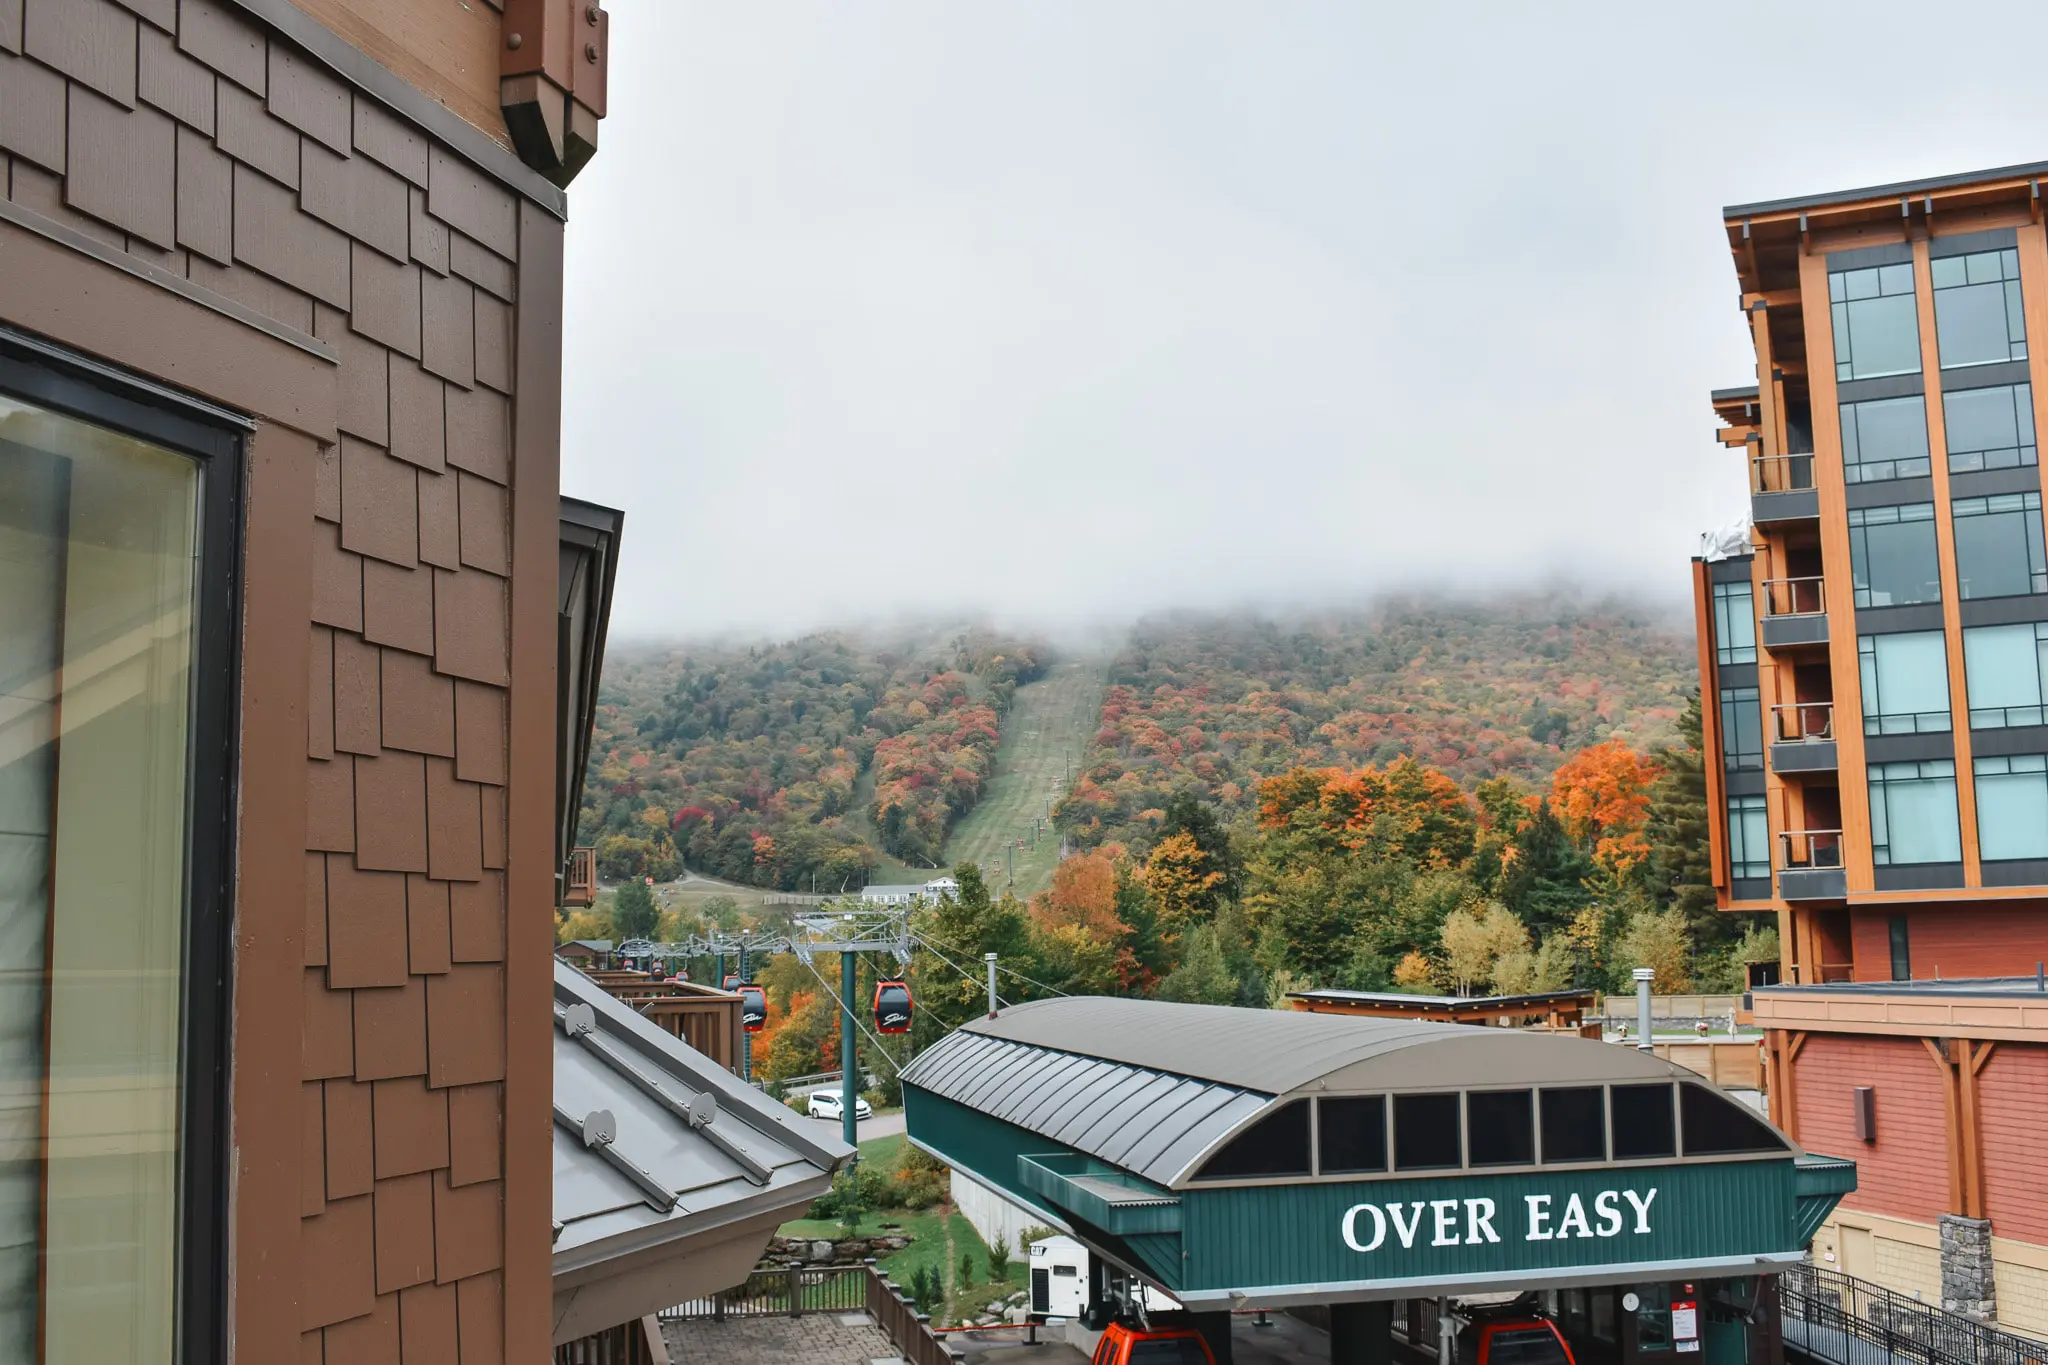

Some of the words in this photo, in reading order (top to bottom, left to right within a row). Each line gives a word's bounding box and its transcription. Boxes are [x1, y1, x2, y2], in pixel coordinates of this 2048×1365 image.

[1341, 1198, 1500, 1252] OVER
[1524, 1188, 1657, 1240] EASY
[1030, 1246, 1044, 1256] CAT
